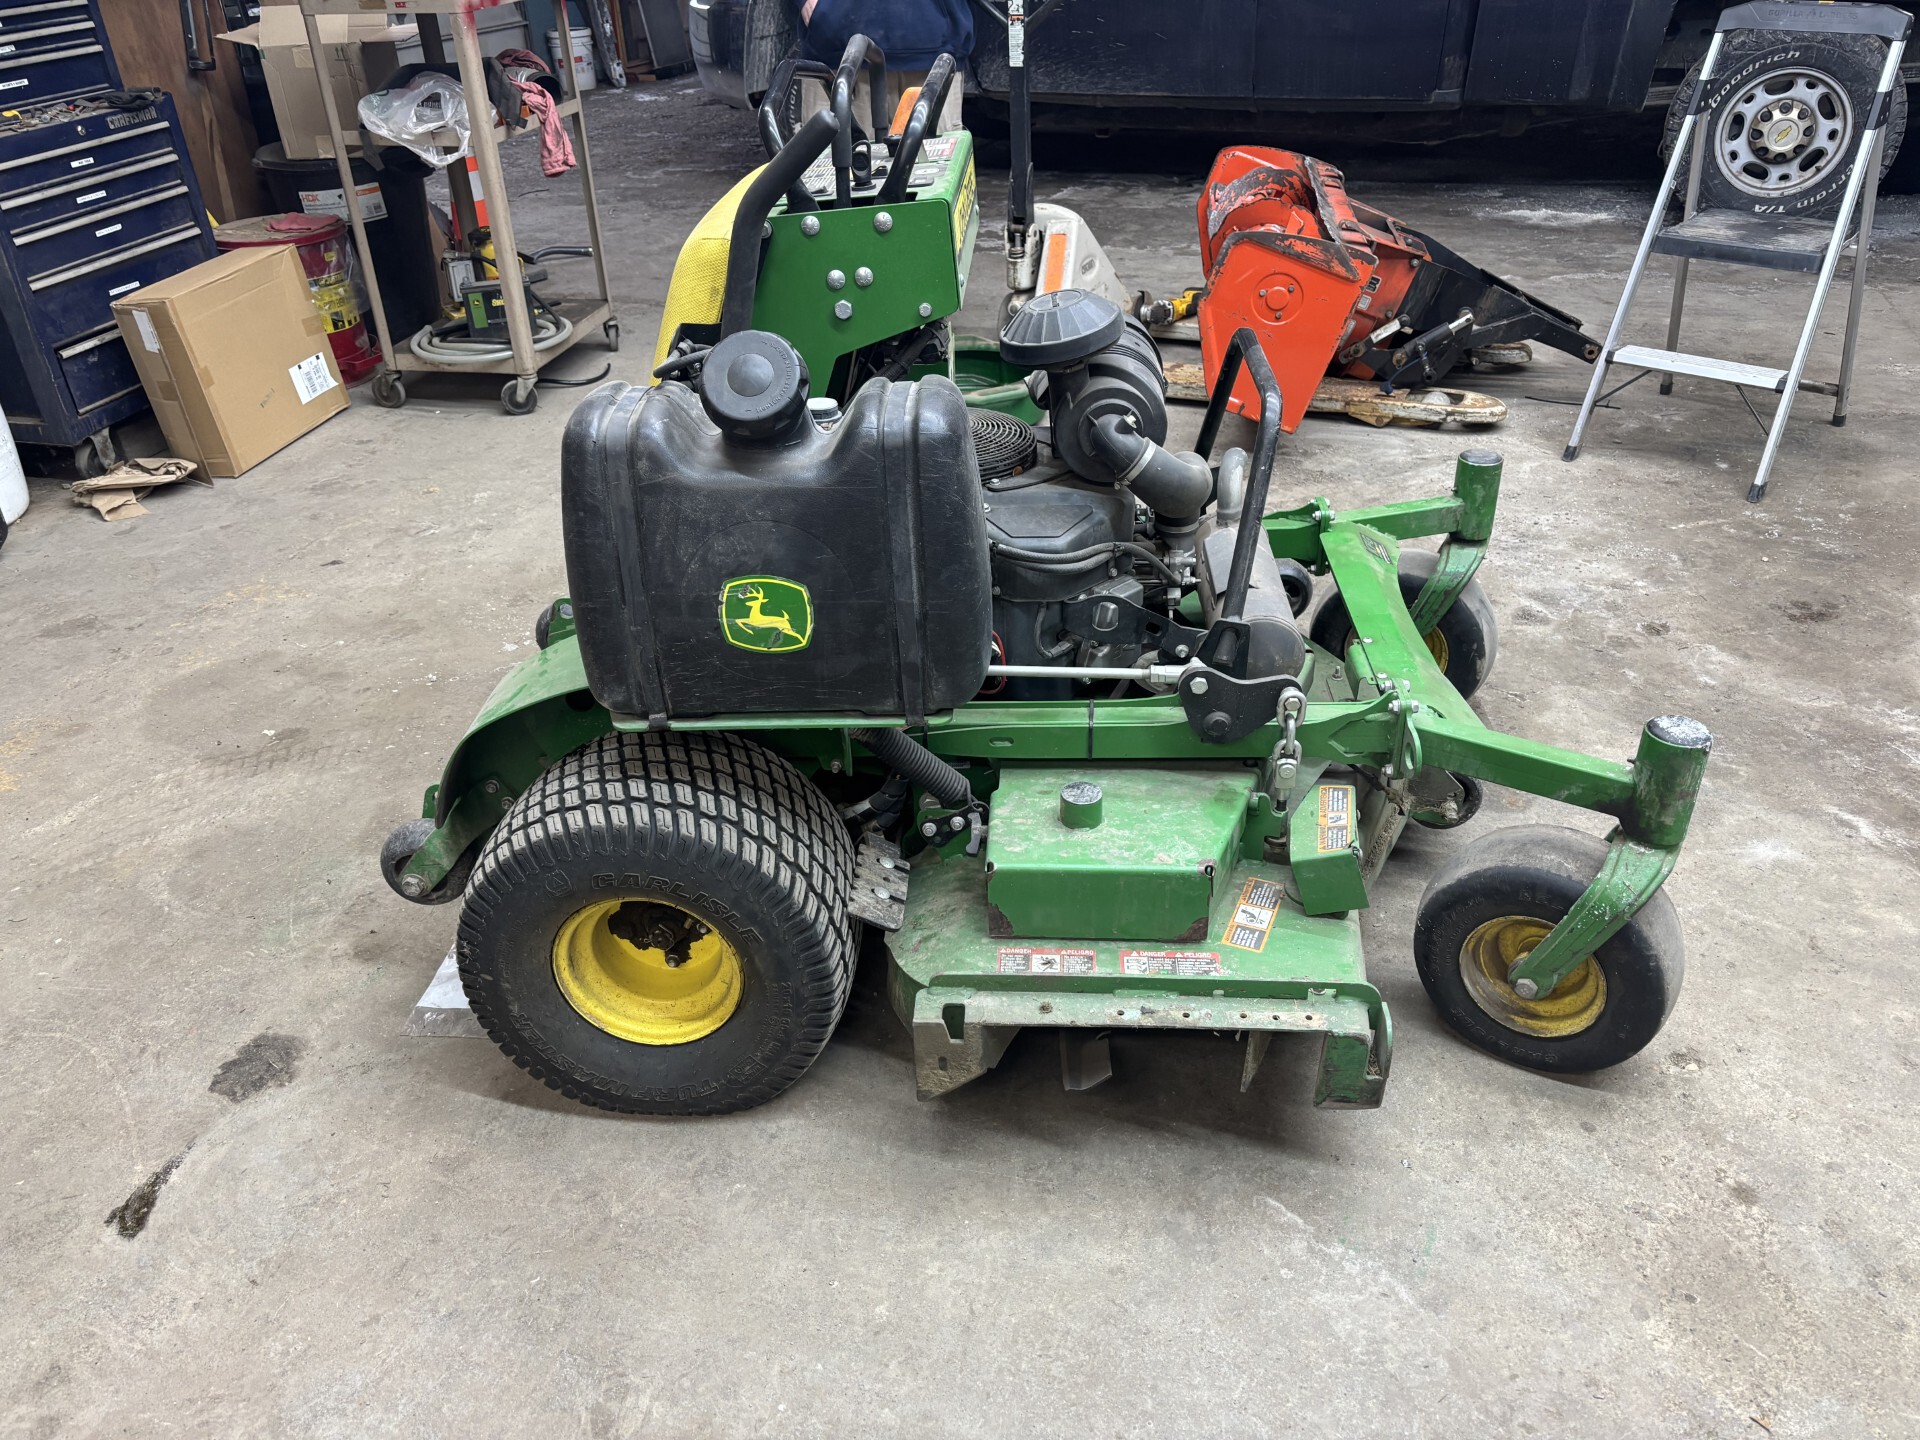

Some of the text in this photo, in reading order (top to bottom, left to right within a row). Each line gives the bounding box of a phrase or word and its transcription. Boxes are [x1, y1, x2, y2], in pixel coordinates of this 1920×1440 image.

[1711, 50, 1800, 108] Goodrich
[105, 106, 158, 130] CRAFTSMAN
[301, 193, 321, 203] HDX
[1754, 163, 1854, 214] errain T/A
[591, 872, 765, 946] CARLISLE
[510, 1012, 720, 1102] TURF MASTER
